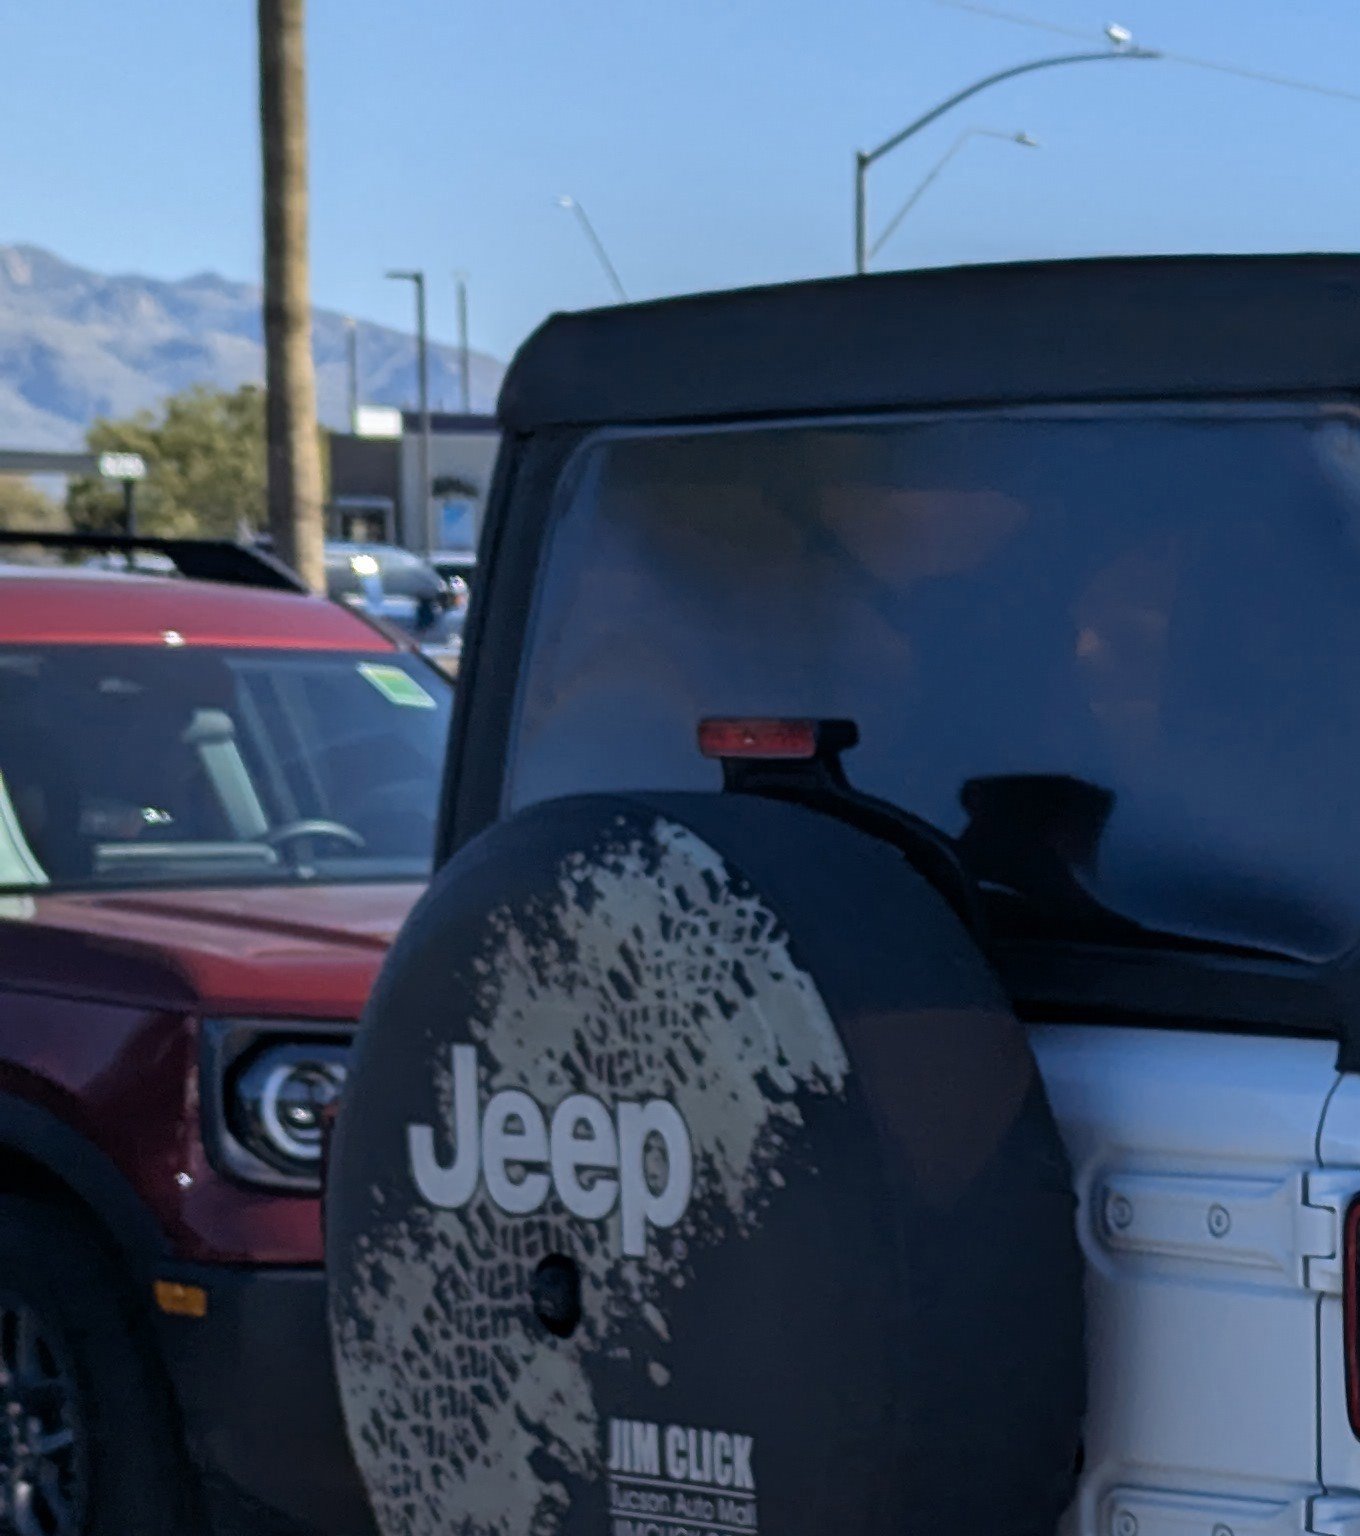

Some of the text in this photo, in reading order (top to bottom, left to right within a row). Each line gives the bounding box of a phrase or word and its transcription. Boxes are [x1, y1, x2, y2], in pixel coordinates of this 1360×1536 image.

[407, 1043, 693, 1257] Jeep
[608, 1418, 756, 1491] JIM CLICK
[608, 1482, 758, 1527] Tucson Auto Mall
